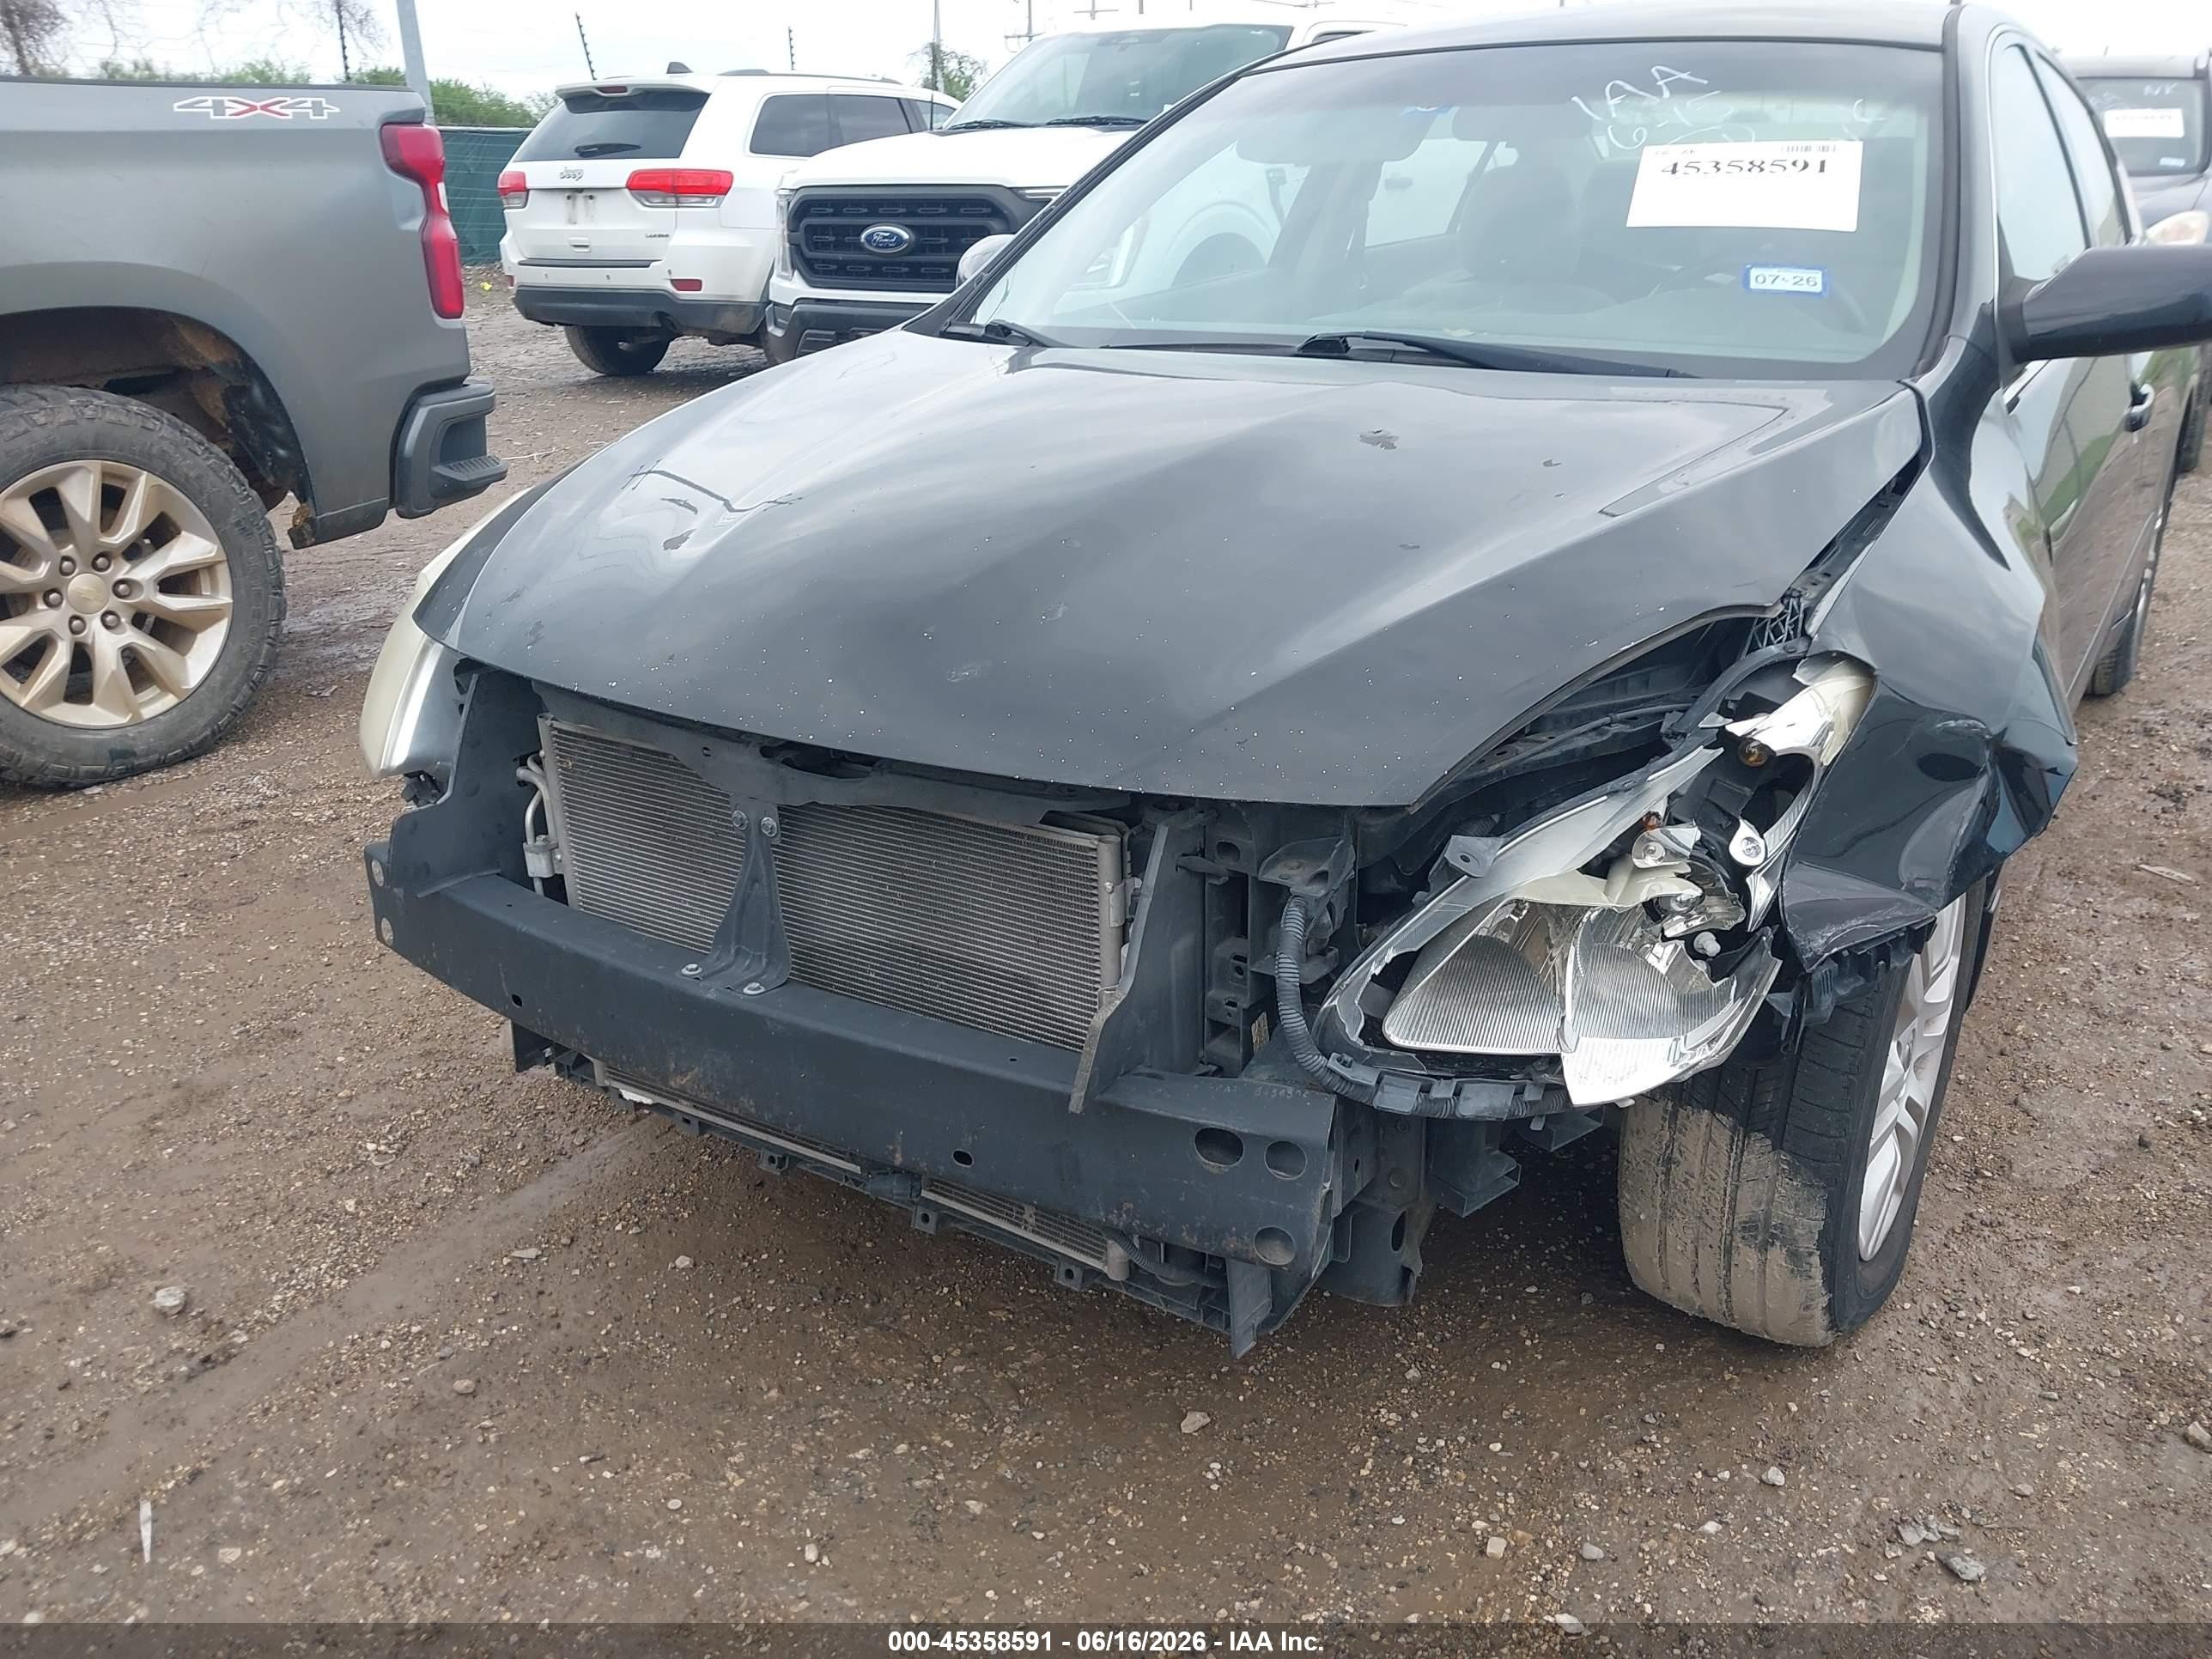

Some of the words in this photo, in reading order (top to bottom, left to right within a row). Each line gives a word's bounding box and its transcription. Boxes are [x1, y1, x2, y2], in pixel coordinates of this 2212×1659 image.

[1662, 158, 1826, 175] 45358591
[872, 231, 898, 247] Ford
[1754, 272, 1819, 288] 07-26
